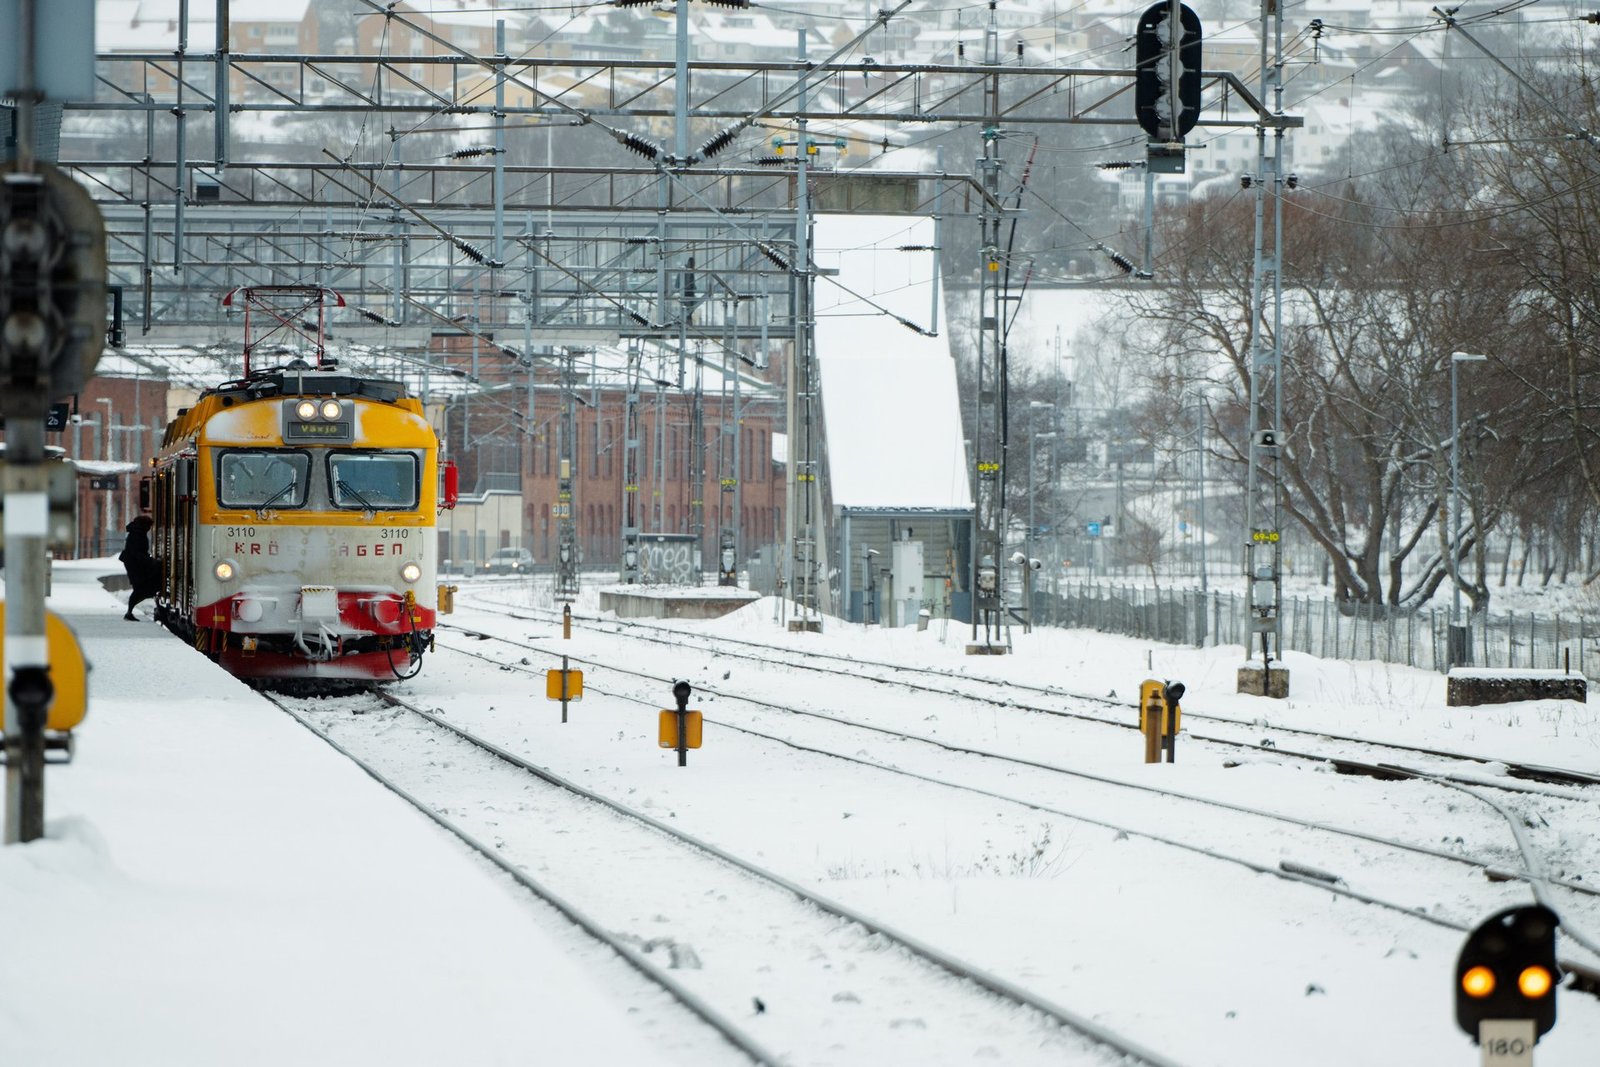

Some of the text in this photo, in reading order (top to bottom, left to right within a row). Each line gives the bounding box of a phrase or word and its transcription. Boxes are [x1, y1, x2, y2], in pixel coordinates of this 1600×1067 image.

[48, 416, 58, 425] 2b
[301, 424, 337, 434] Växjö
[227, 527, 256, 538] 3110
[381, 528, 409, 539] 3110
[1253, 532, 1279, 541] 69-10
[234, 540, 403, 557] KRÖÅGEN
[1488, 1038, 1525, 1056] 180
